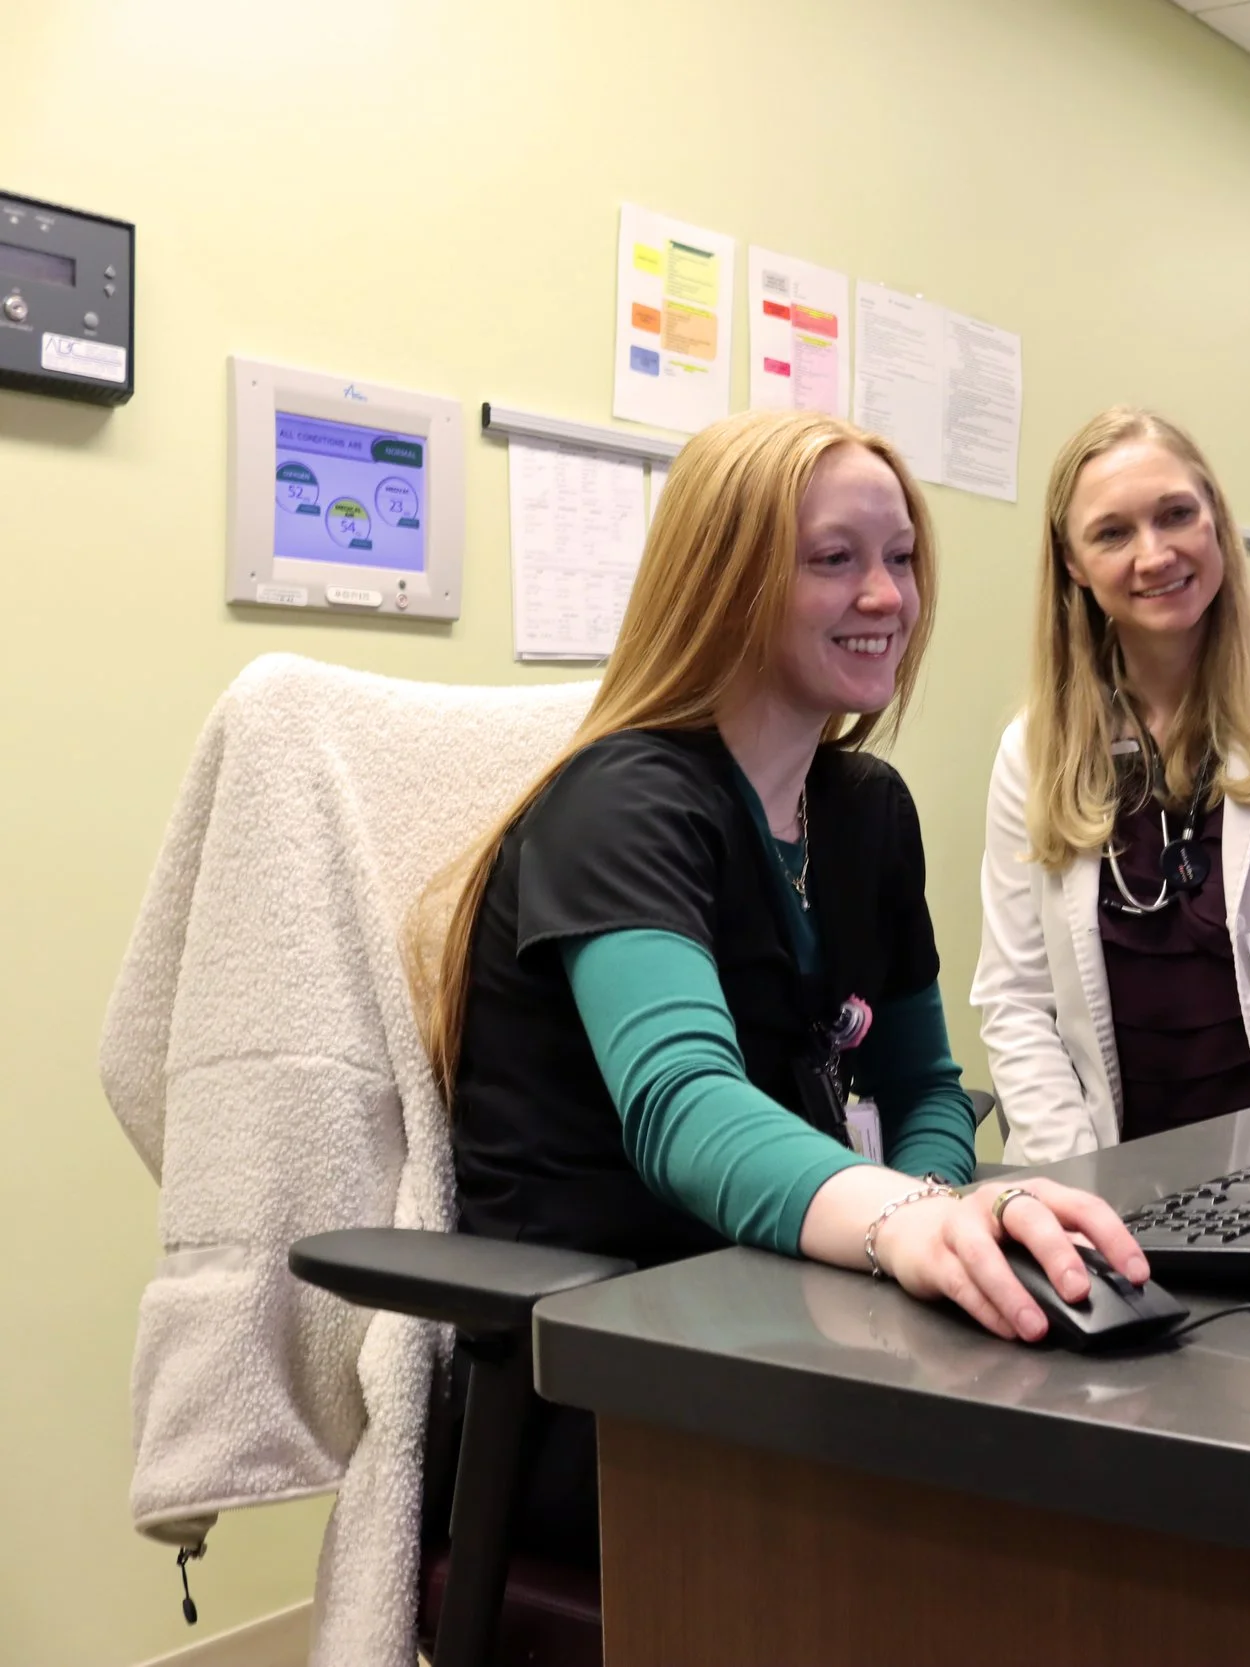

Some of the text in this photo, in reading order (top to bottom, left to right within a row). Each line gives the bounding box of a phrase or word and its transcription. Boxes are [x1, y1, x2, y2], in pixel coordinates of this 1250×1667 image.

[279, 429, 362, 449] ALL CONDITIONS ARE
[288, 485, 303, 498] 52
[390, 499, 403, 513] 23
[340, 520, 356, 534] 54
